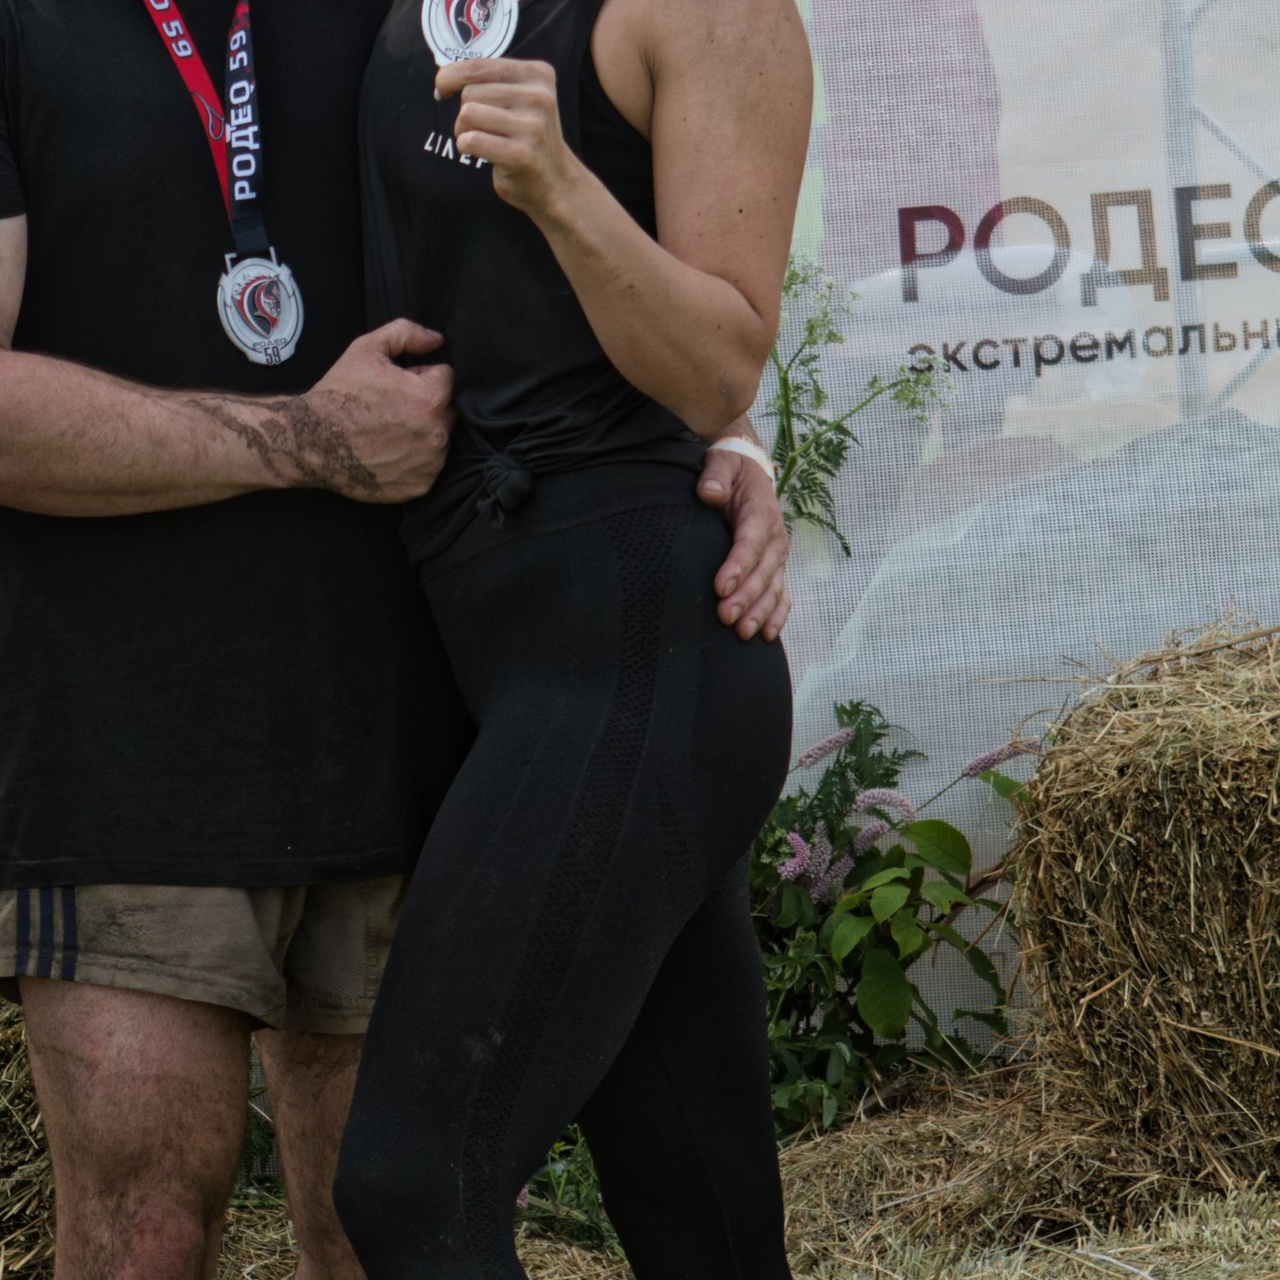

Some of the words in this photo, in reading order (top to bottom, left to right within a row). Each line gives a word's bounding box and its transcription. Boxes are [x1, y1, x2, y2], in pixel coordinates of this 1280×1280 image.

[162, 20, 193, 58] 59
[229, 30, 248, 71] 59
[229, 80, 260, 201] РОДЕО
[264, 346, 281, 365] 59
